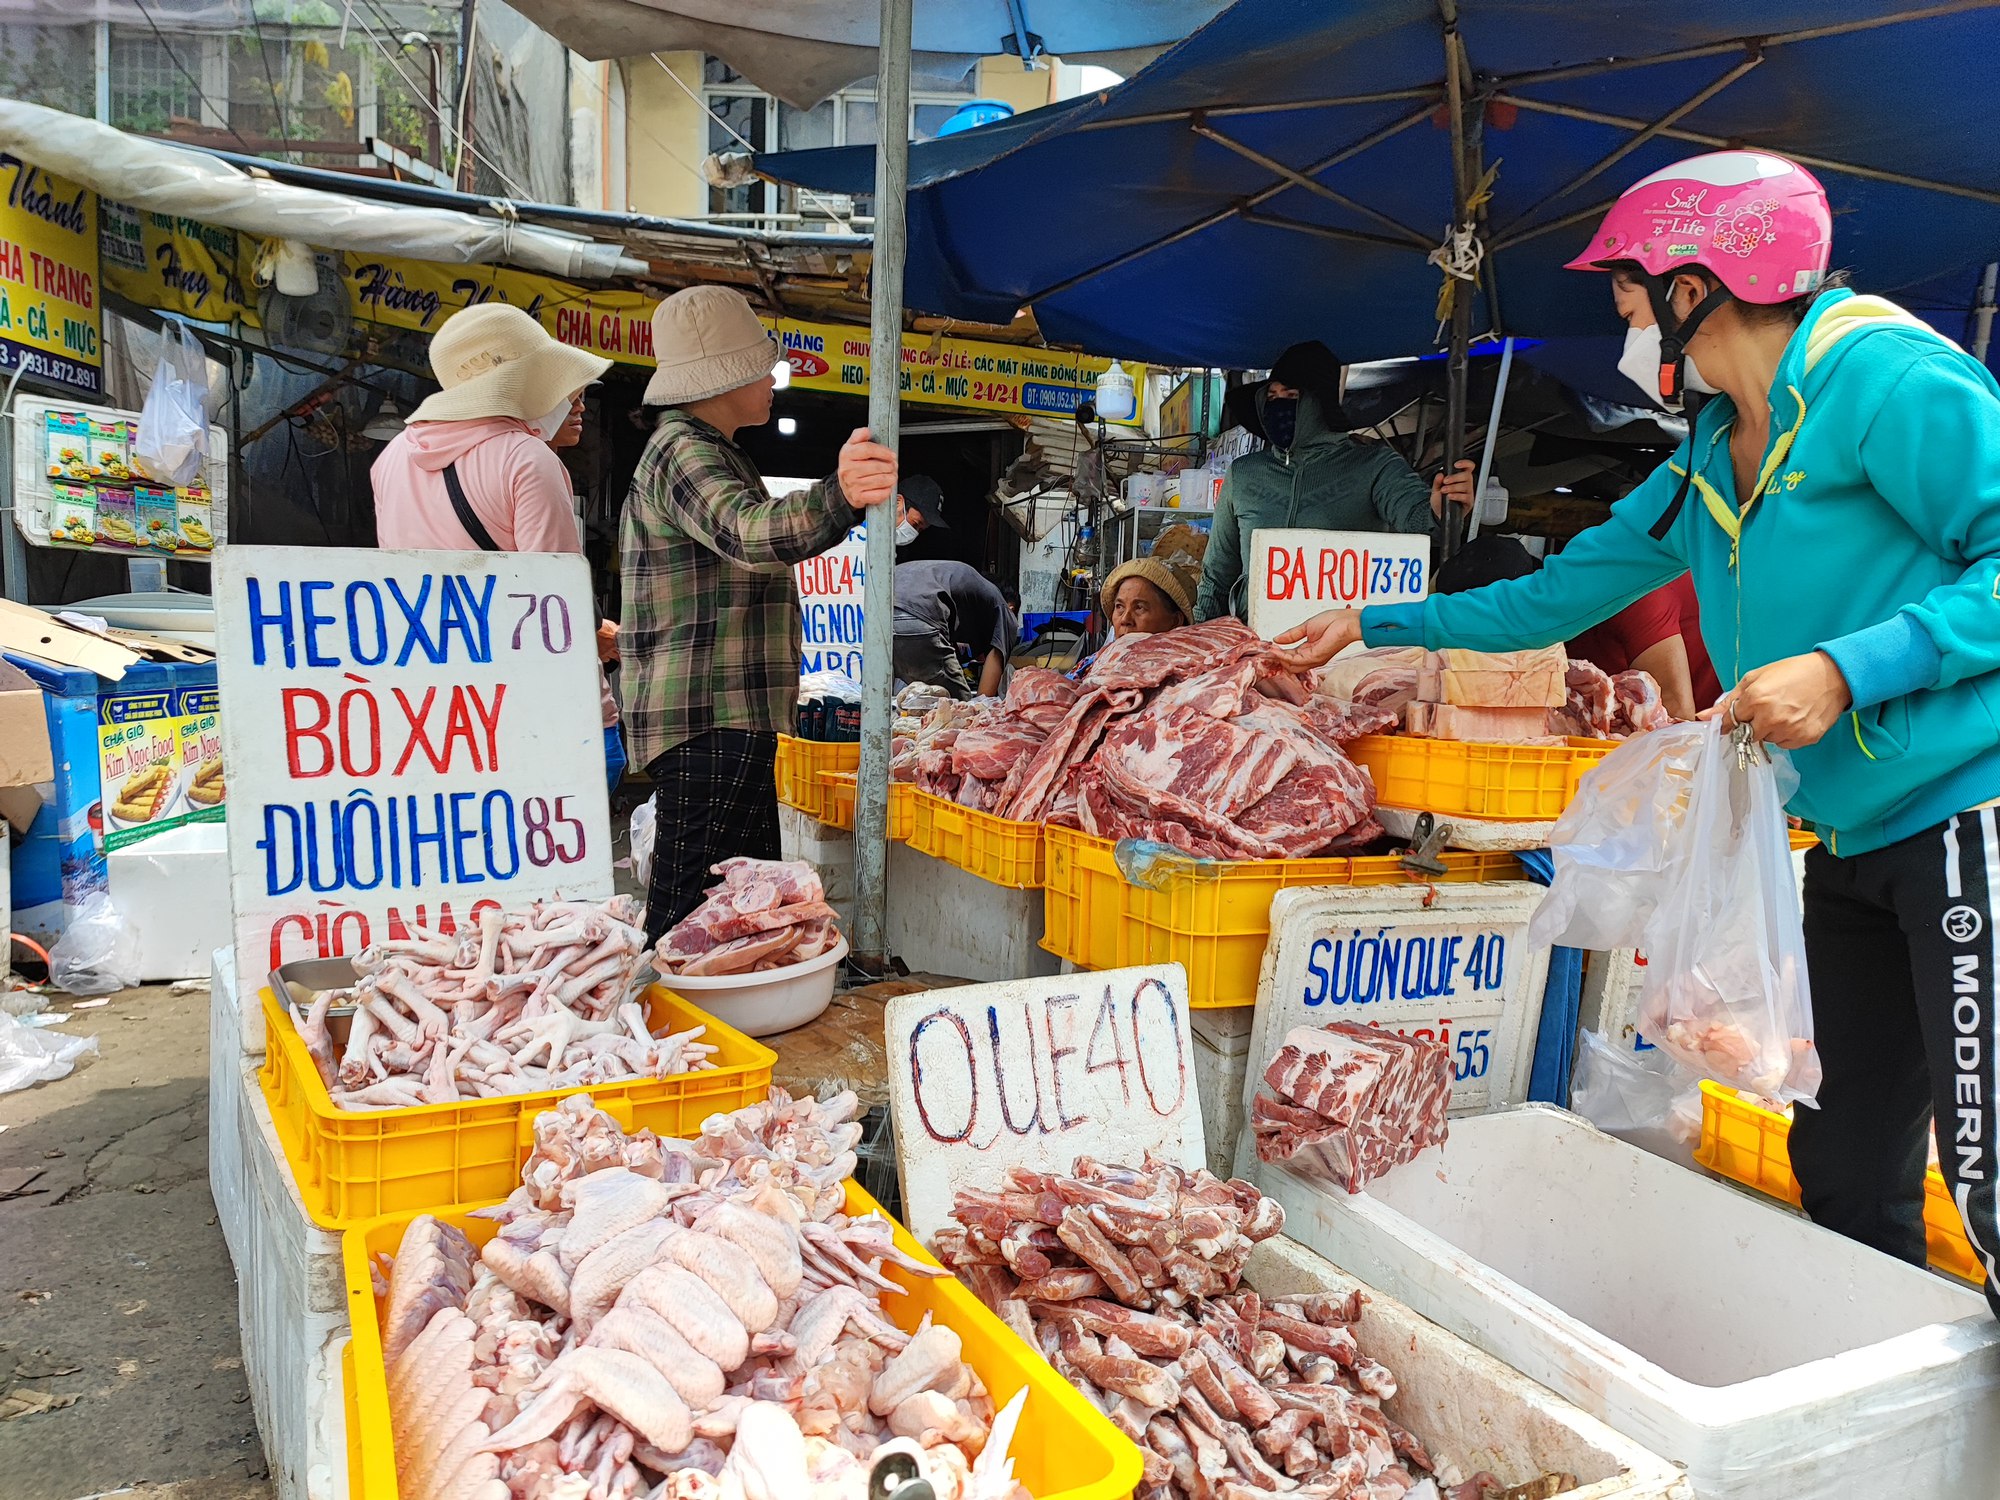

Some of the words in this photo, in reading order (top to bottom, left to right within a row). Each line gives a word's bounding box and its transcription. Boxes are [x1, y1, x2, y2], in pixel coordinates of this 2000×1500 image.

[0, 152, 88, 235] Thành
[1665, 187, 1732, 217] Smile
[1670, 218, 1706, 236] Life
[30, 250, 93, 310] TRANG
[355, 263, 441, 327] Hùng
[28, 302, 48, 341] CÁ
[64, 317, 96, 358] MỰC
[556, 298, 592, 348] CHẢ
[599, 307, 622, 352] CÁ
[629, 319, 655, 357] NH
[782, 330, 824, 353] HÀNG
[842, 364, 864, 385] HEO
[900, 367, 912, 391] GÀ
[922, 370, 935, 393] CÁ
[945, 372, 968, 400] MỰC
[973, 381, 1018, 404] 24/24
[843, 340, 871, 358] CHUY
[974, 354, 994, 372] CÁC
[1021, 359, 1048, 379] HÀNG
[1051, 363, 1077, 382] ĐÔNG
[1080, 370, 1101, 387] LẠN
[1267, 546, 1309, 600] BA
[507, 594, 572, 654] 70
[104, 752, 125, 780] Kim
[151, 729, 175, 760] Food
[523, 795, 586, 867] 85
[1455, 1028, 1492, 1081] 55
[1953, 954, 1985, 1180] MODERN
